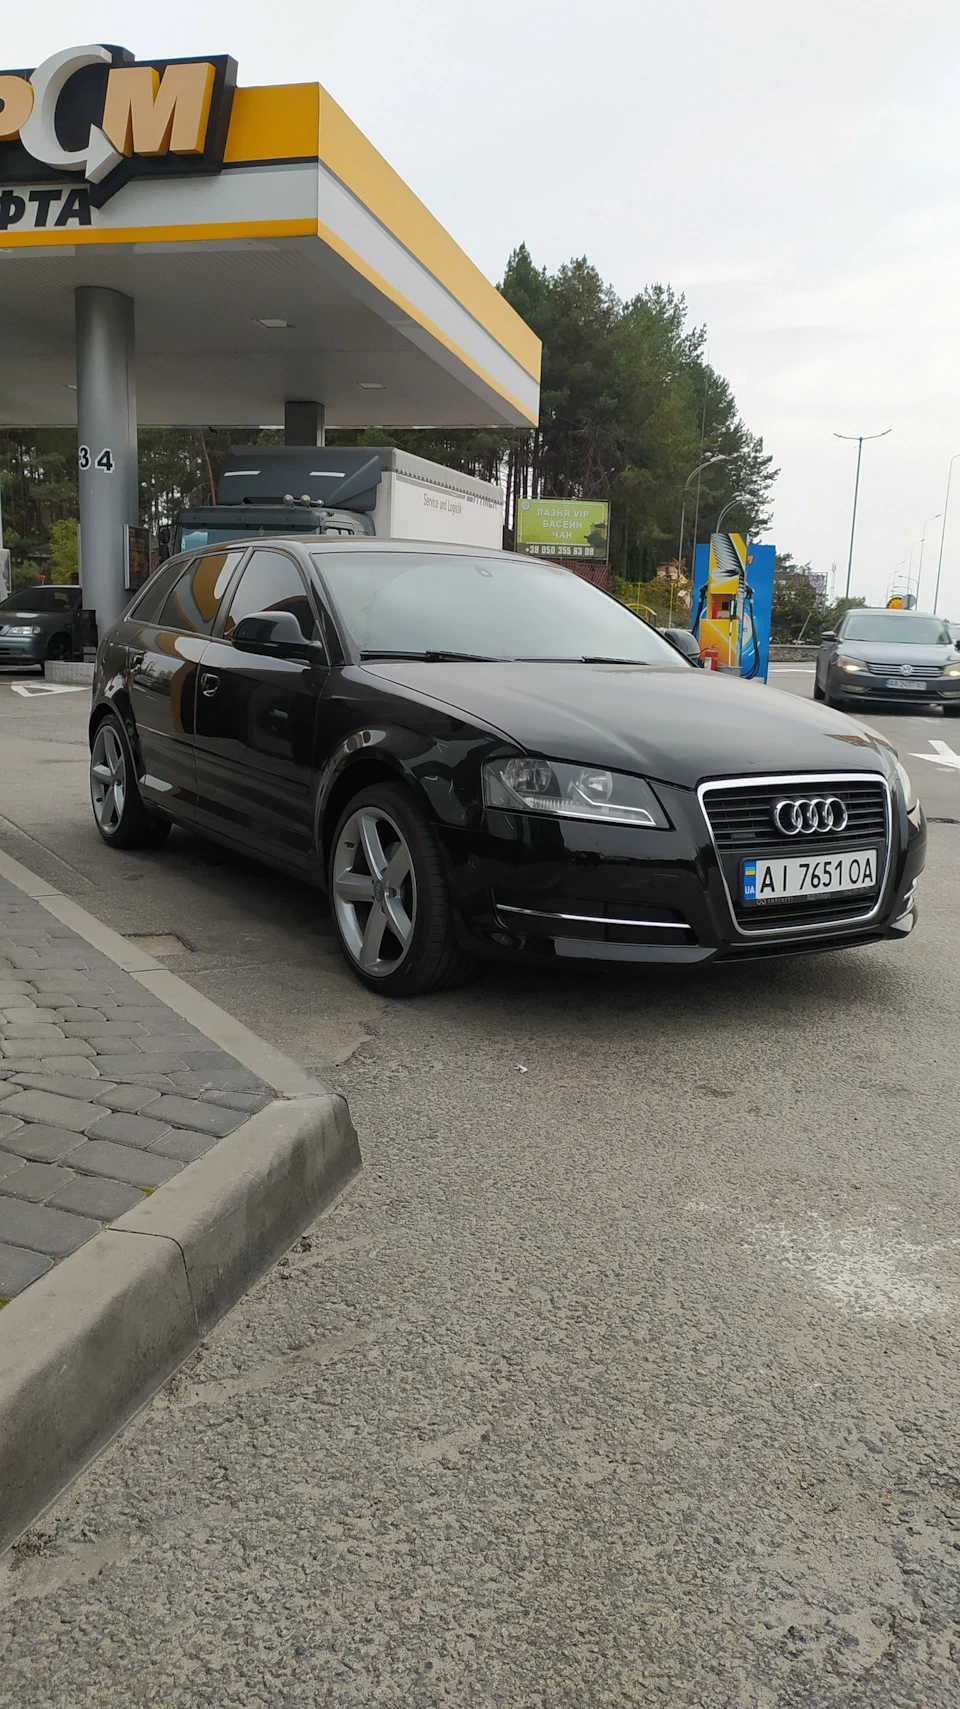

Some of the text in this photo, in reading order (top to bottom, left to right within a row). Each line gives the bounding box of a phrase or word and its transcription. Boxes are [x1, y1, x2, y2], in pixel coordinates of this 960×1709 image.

[79, 445, 115, 473] 3 4
[424, 492, 439, 508] Service
[447, 499, 462, 516] Logistik
[537, 508, 589, 518] ЛАЗНЯ VIP
[542, 519, 583, 529] БАСЕЙН
[552, 531, 572, 539] ЧАН
[525, 545, 595, 556] +38 050 355 63 08
[760, 857, 873, 894] AI 7651 OA
[745, 886, 755, 894] UA
